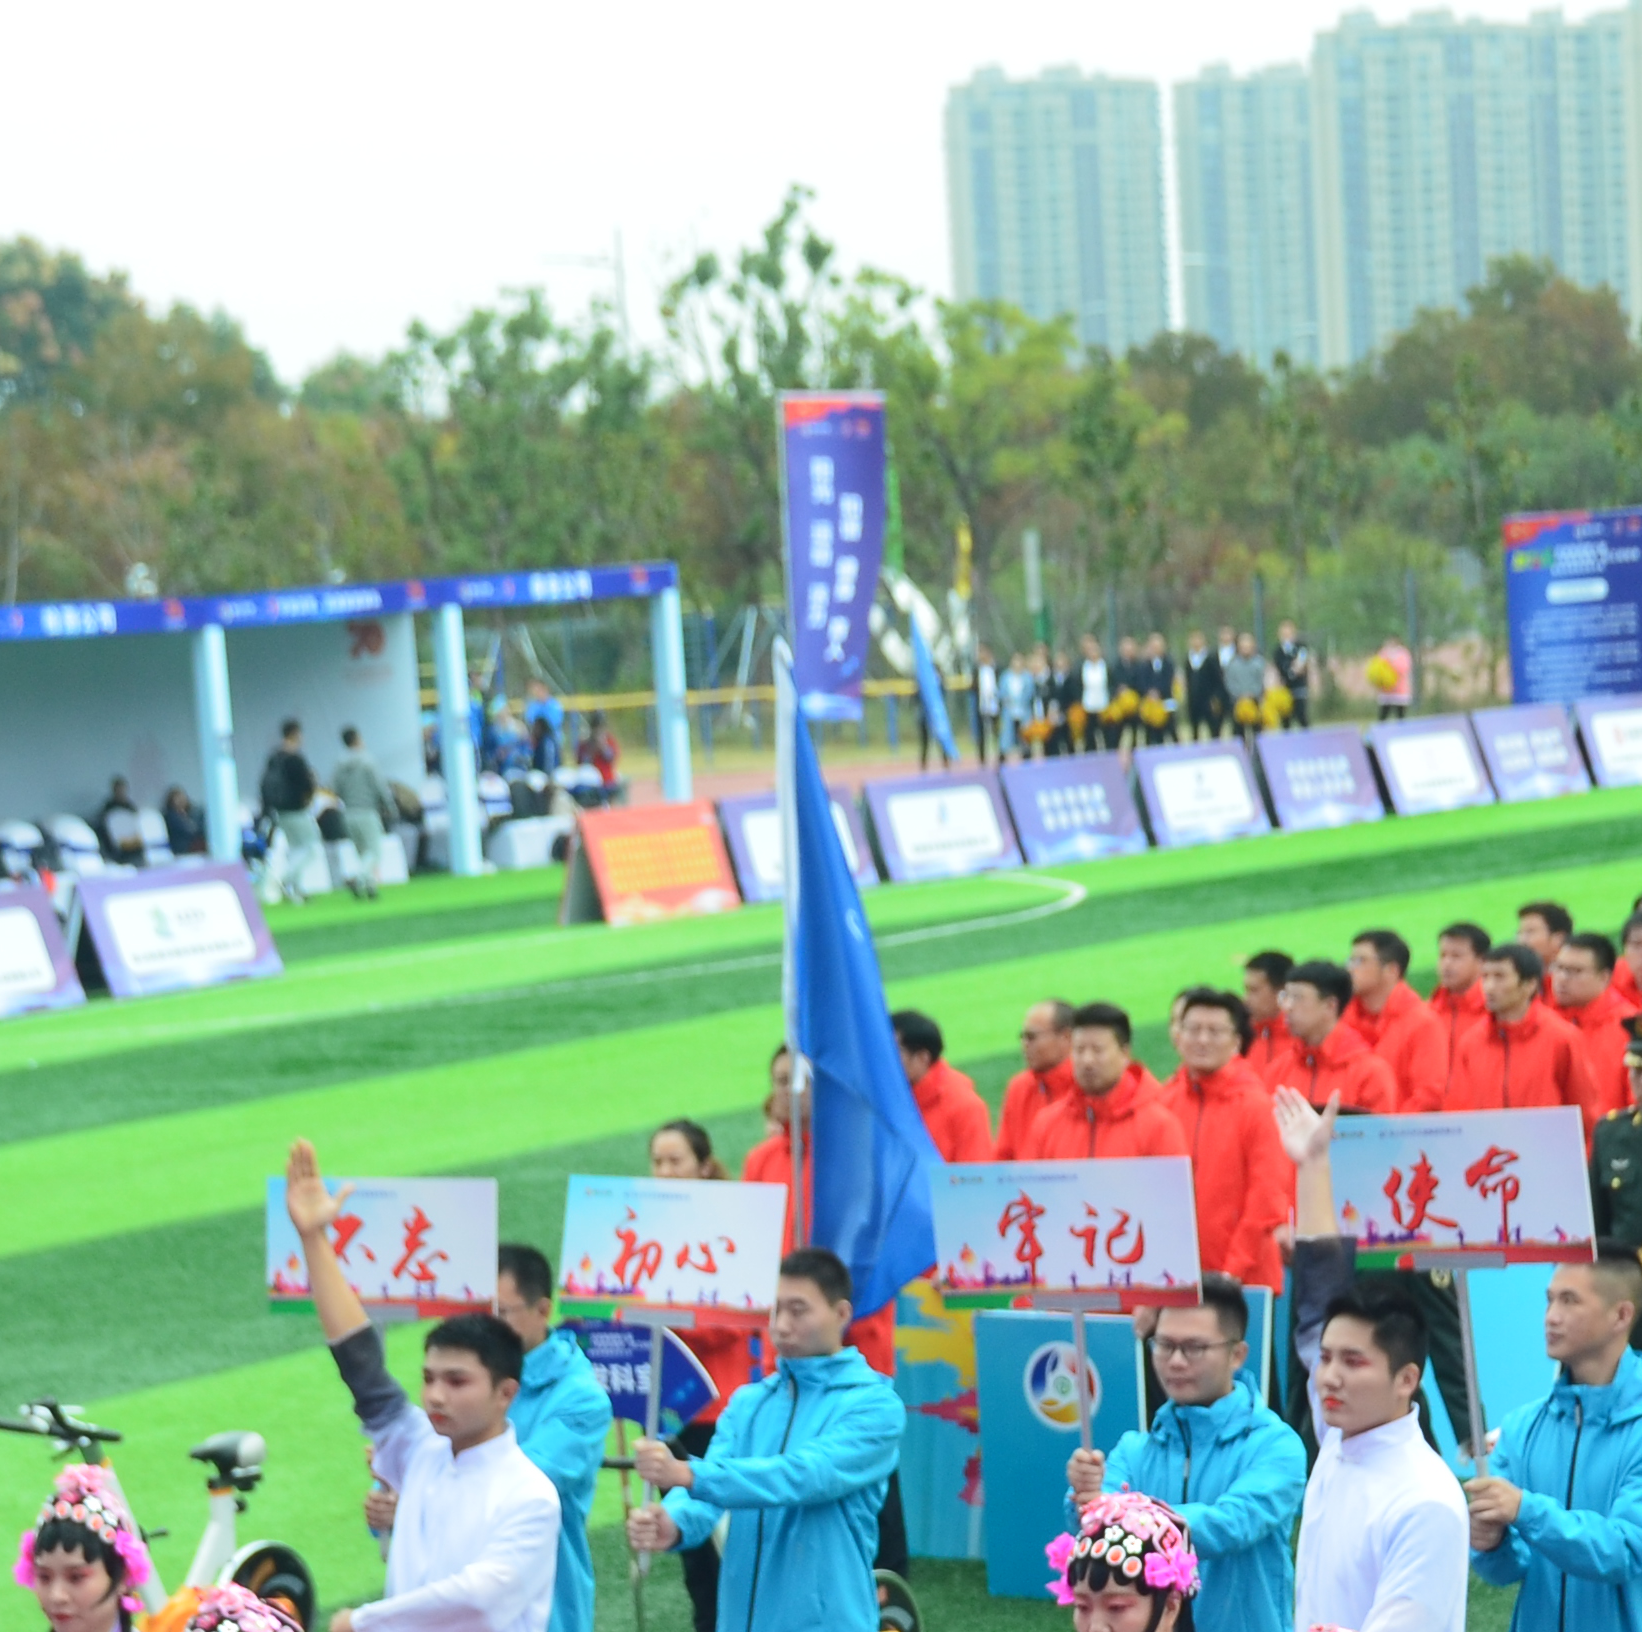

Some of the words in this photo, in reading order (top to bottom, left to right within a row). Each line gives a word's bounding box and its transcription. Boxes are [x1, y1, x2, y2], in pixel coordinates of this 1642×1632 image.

[998, 1188, 1145, 1287] 牢记
[1382, 1144, 1520, 1243] 使命
[331, 1205, 450, 1283] 不忘
[613, 1206, 737, 1285] 初心
